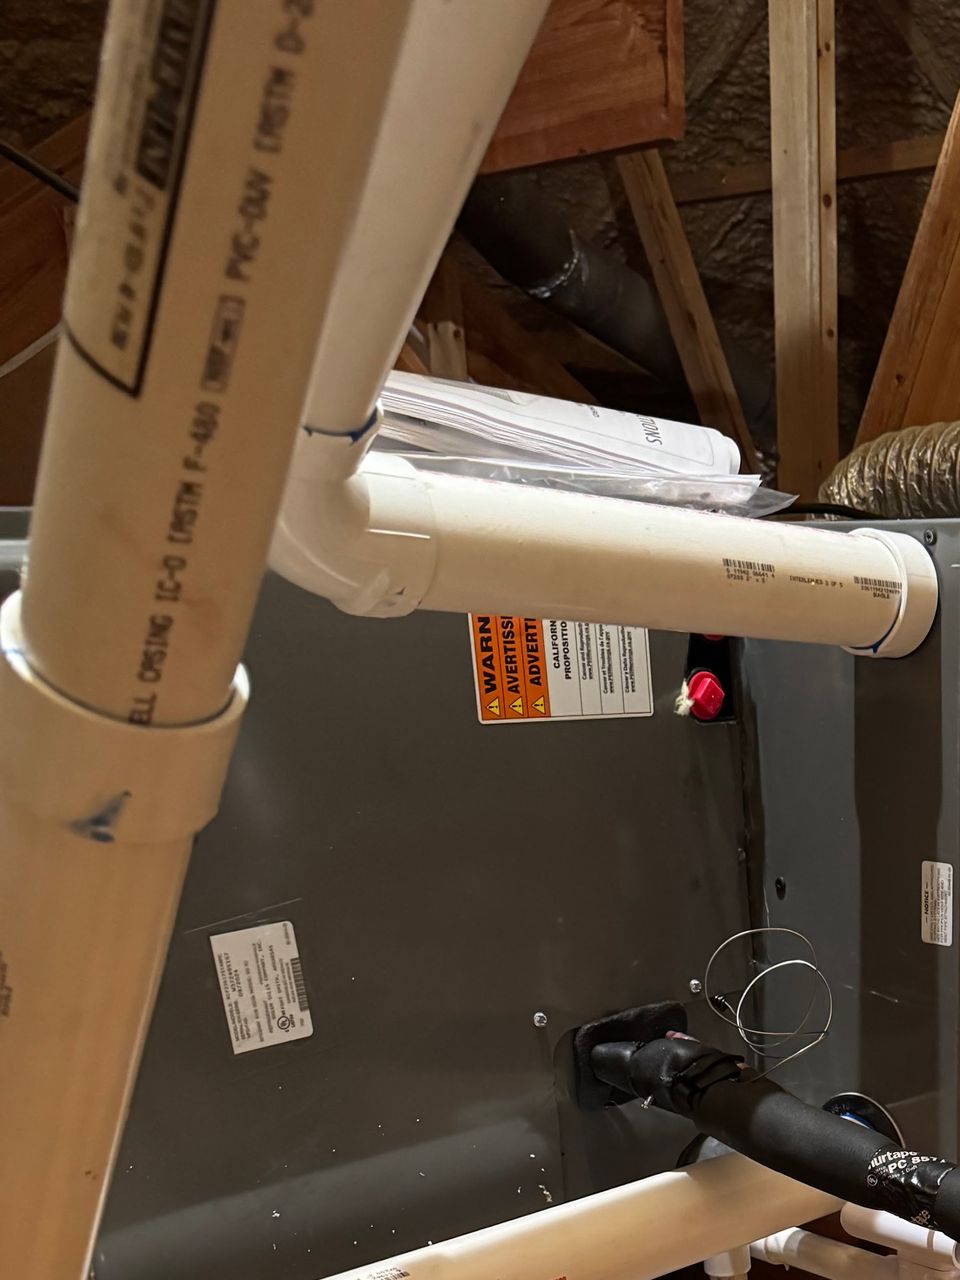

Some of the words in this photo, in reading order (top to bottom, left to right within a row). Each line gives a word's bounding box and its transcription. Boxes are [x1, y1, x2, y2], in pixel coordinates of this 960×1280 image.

[137, 614, 174, 684] CASING
[477, 616, 497, 694] WARN
[560, 621, 573, 680] PROPOSITIO
[887, 1159, 908, 1174] PC
